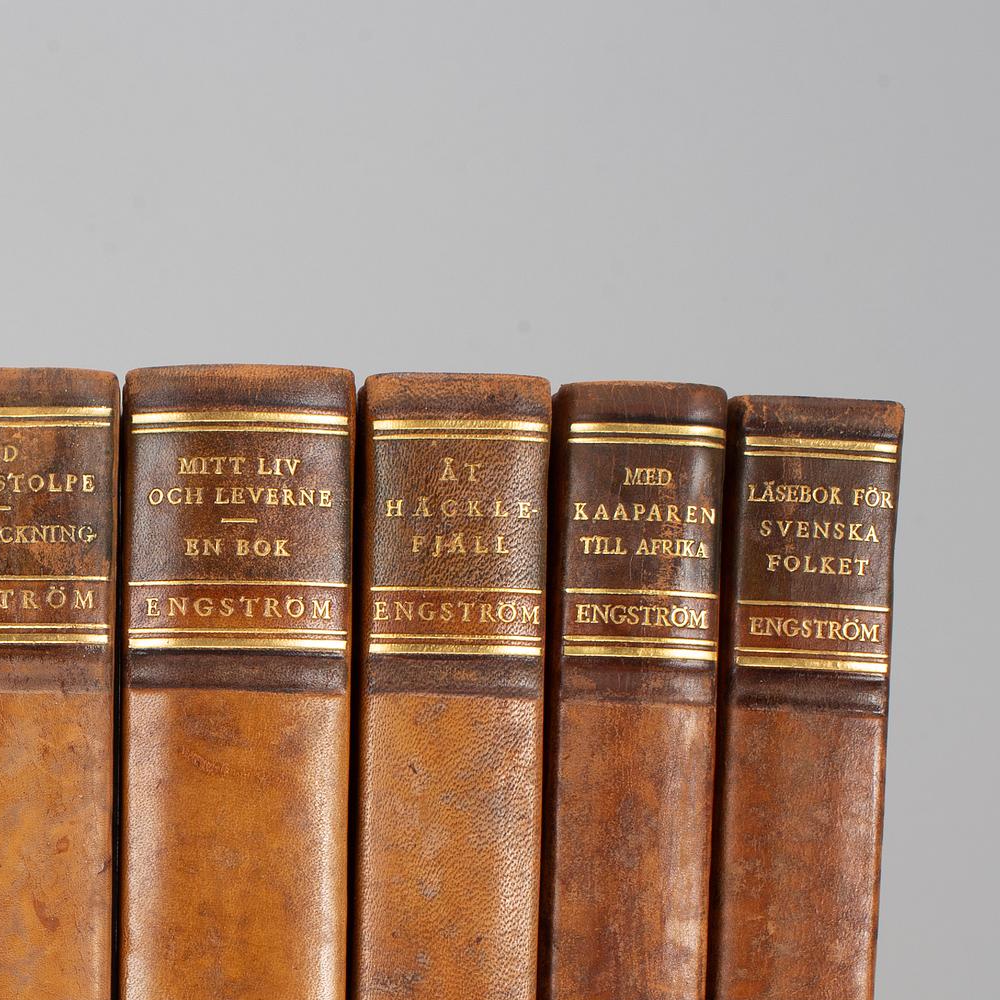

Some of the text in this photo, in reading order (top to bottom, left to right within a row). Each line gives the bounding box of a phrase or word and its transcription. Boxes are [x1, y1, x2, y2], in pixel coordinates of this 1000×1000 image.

[177, 456, 301, 476] MITT LIV
[439, 457, 482, 481] ÅT
[623, 467, 673, 486] MED
[149, 487, 333, 508] OCH LEVERNE
[747, 480, 894, 509] LÄSEBOK FÖR
[572, 502, 716, 525] KAAPAREN
[760, 519, 880, 543] SVENSKA
[184, 538, 291, 556] EN BOK
[411, 532, 509, 558] FJÄLL
[579, 535, 710, 559] TILL AFRIKA
[765, 553, 870, 576] FOLKET
[145, 596, 331, 619] ENGSTRÖM
[373, 600, 540, 625] ENGSTRÖM
[575, 603, 709, 629] ENGSTRÖM
[749, 616, 880, 642] ENGSTRÖM
